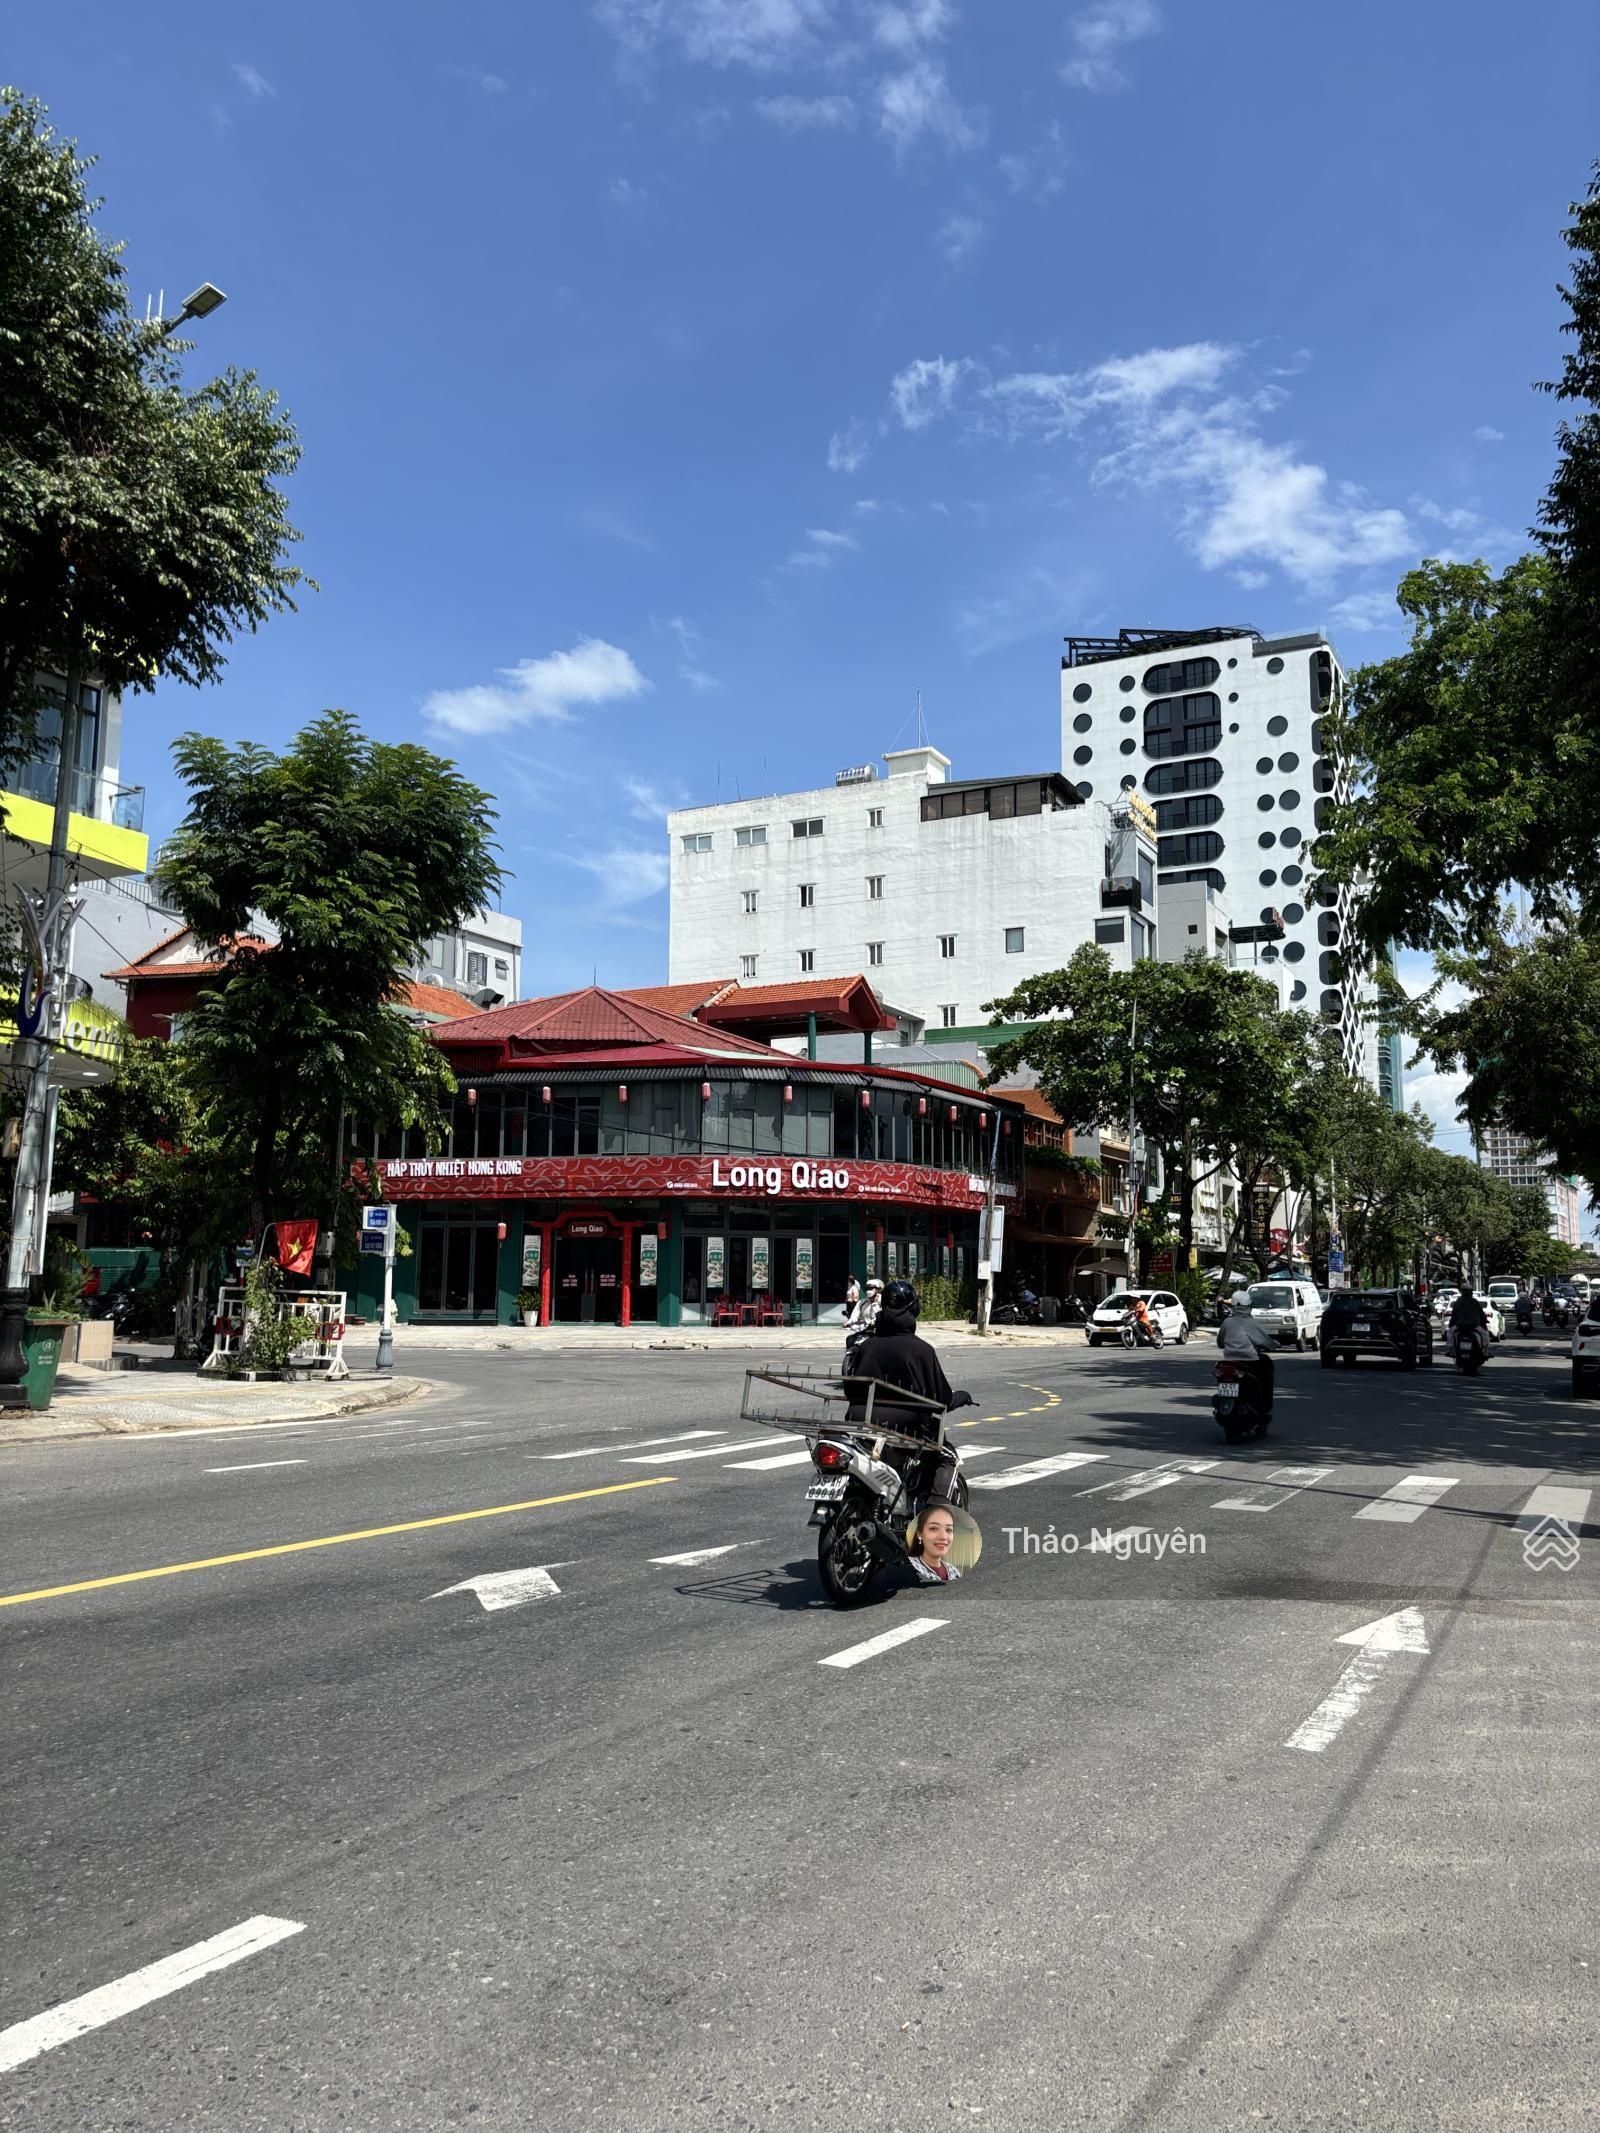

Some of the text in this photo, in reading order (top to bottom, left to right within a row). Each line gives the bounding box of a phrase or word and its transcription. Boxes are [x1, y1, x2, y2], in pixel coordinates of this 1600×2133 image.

[468, 1161, 494, 1176] HONG
[496, 1160, 522, 1175] KONG
[712, 1159, 850, 1195] Long Qiao
[571, 1224, 604, 1234] Long Qiao
